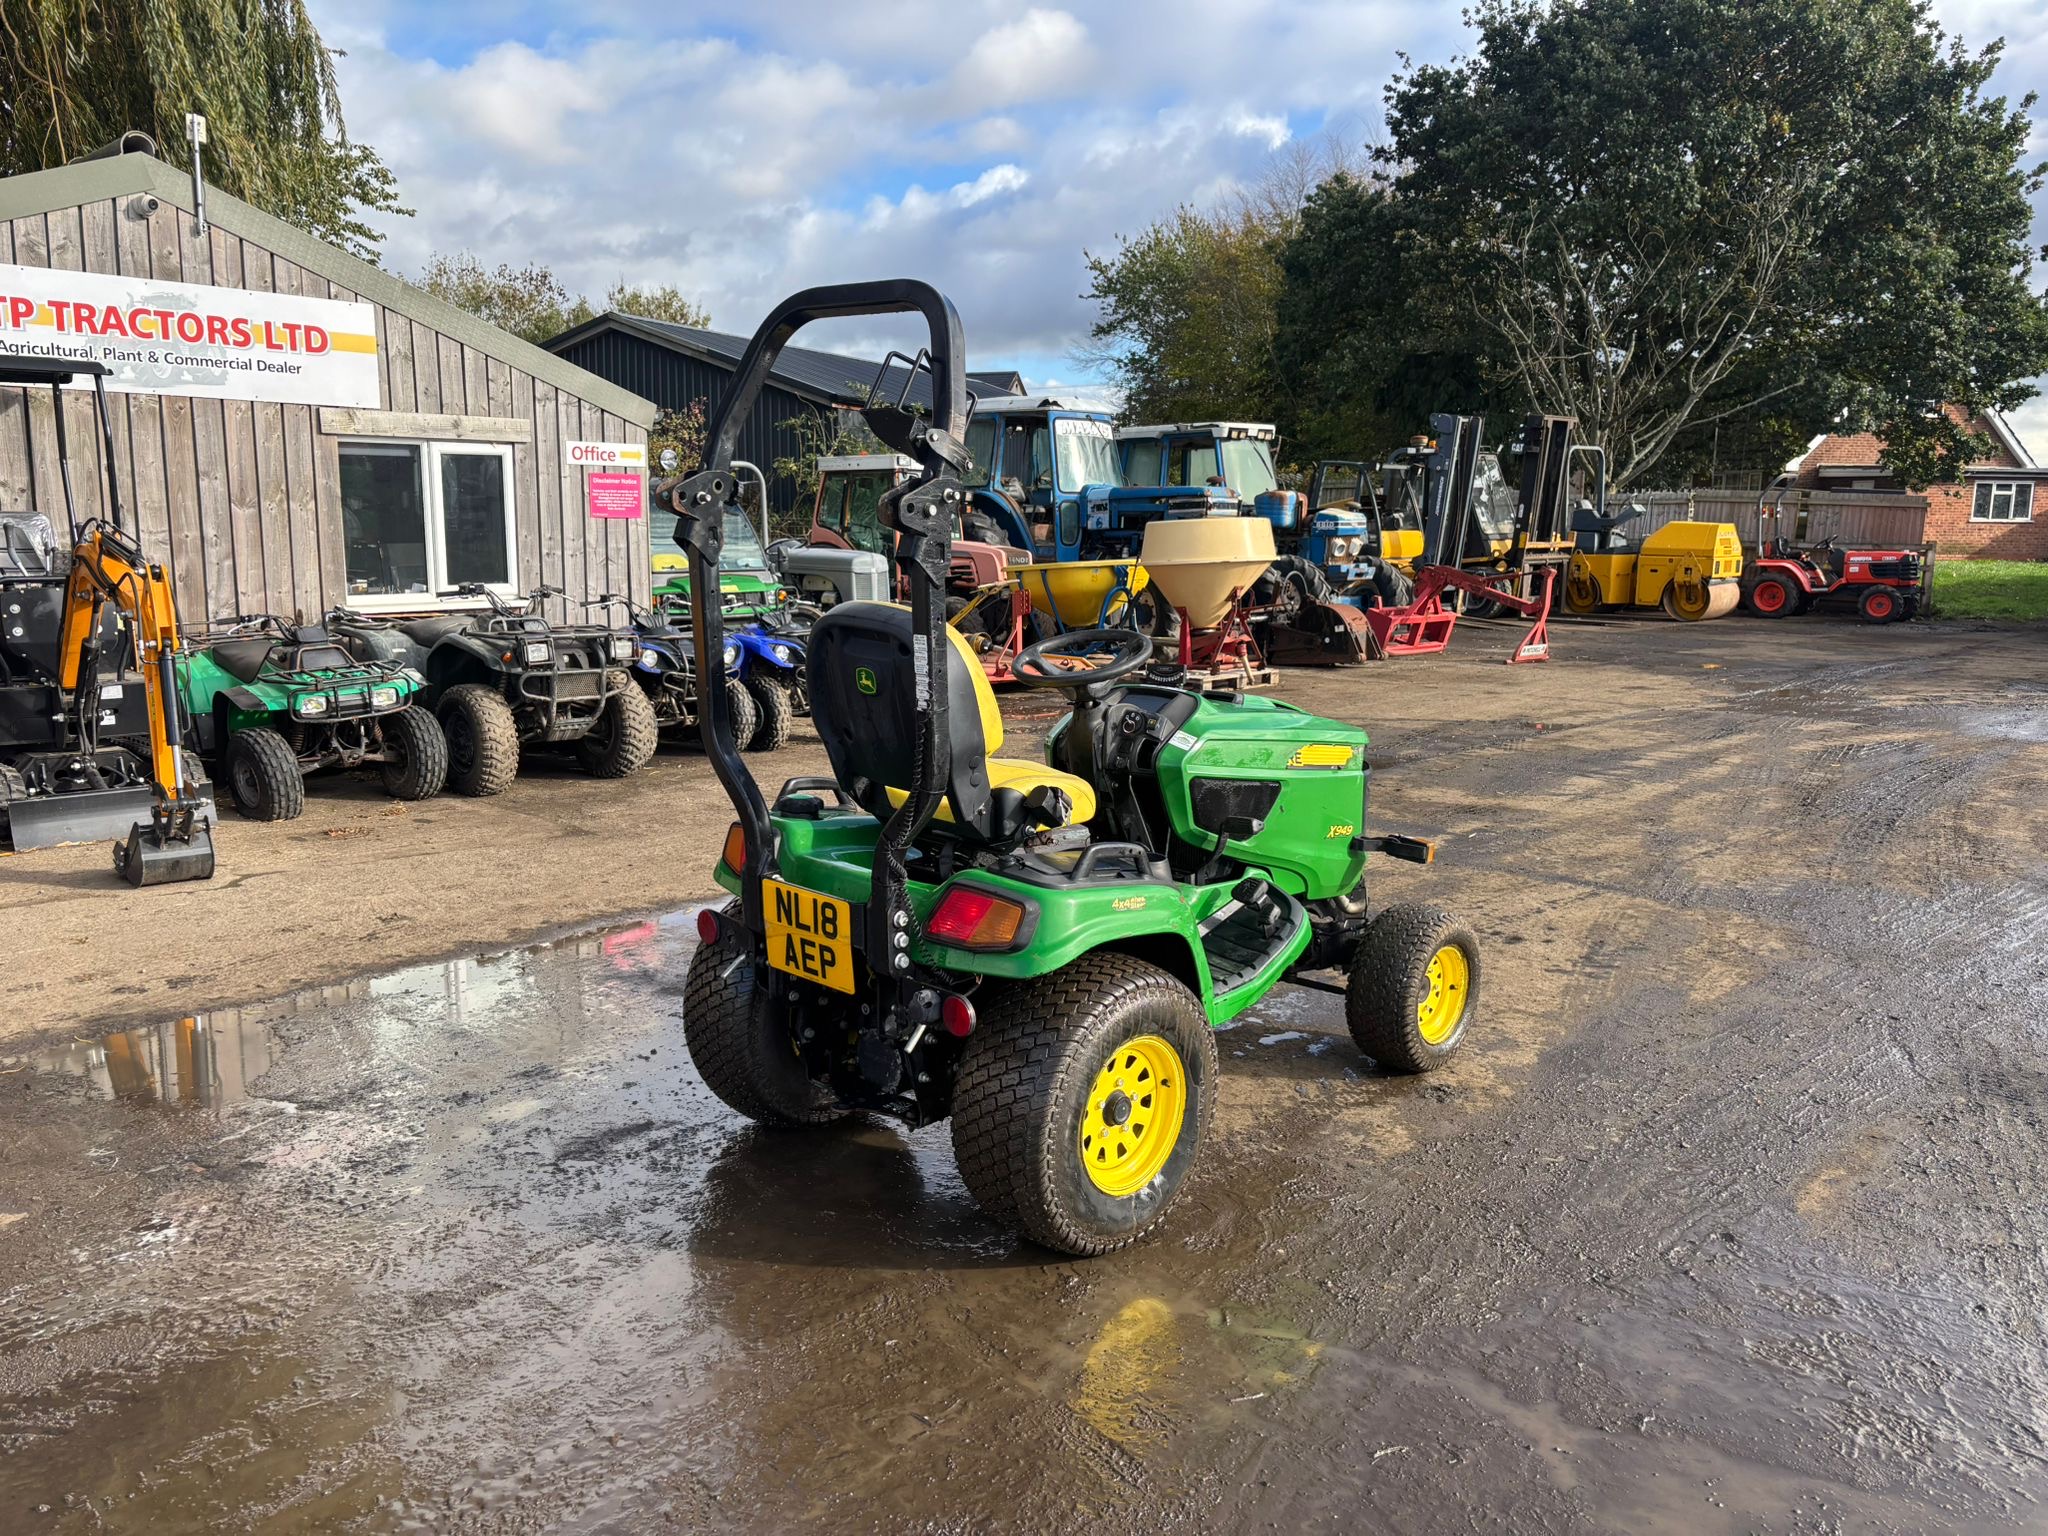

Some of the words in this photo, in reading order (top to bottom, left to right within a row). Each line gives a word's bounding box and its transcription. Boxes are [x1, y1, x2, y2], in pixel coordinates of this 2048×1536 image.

[47, 300, 252, 349] TRACTORS
[264, 321, 329, 354] LTD
[103, 347, 142, 363] Plant
[148, 351, 160, 363] &
[164, 352, 253, 371] Commercial
[257, 360, 302, 375] Dealer
[571, 446, 617, 462] Office
[1511, 442, 1525, 452] CAT
[1327, 825, 1353, 838] X949
[775, 887, 838, 940] NL18
[1111, 898, 1130, 909] 4x4
[785, 933, 836, 979] AEP
